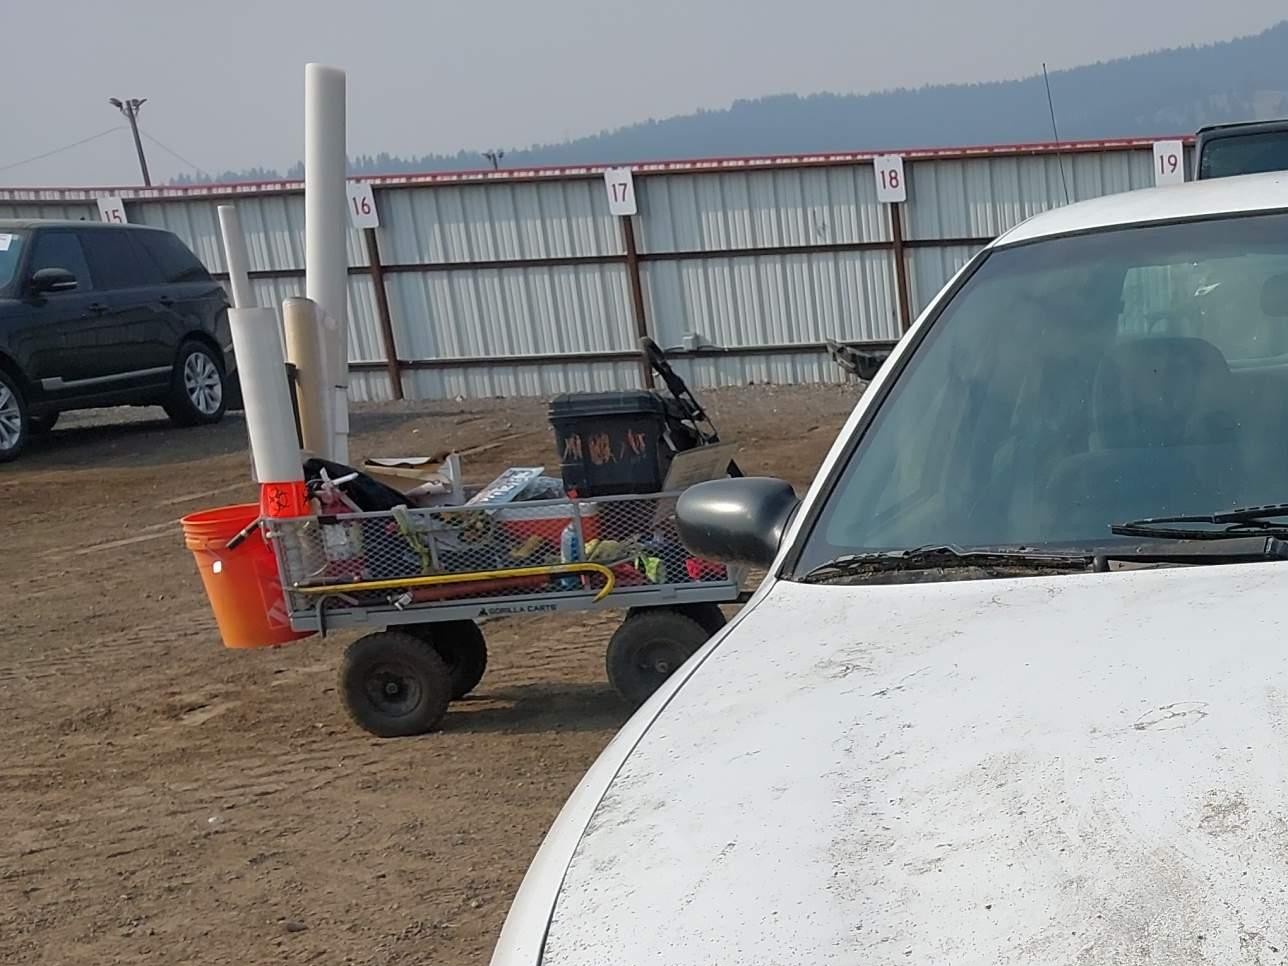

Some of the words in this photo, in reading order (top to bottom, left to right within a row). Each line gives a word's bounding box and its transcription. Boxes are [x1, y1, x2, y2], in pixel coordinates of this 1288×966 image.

[1159, 154, 1178, 175] 19
[879, 168, 900, 190] 18
[611, 182, 628, 203] 17
[104, 208, 123, 224] 15
[352, 196, 372, 216] 16
